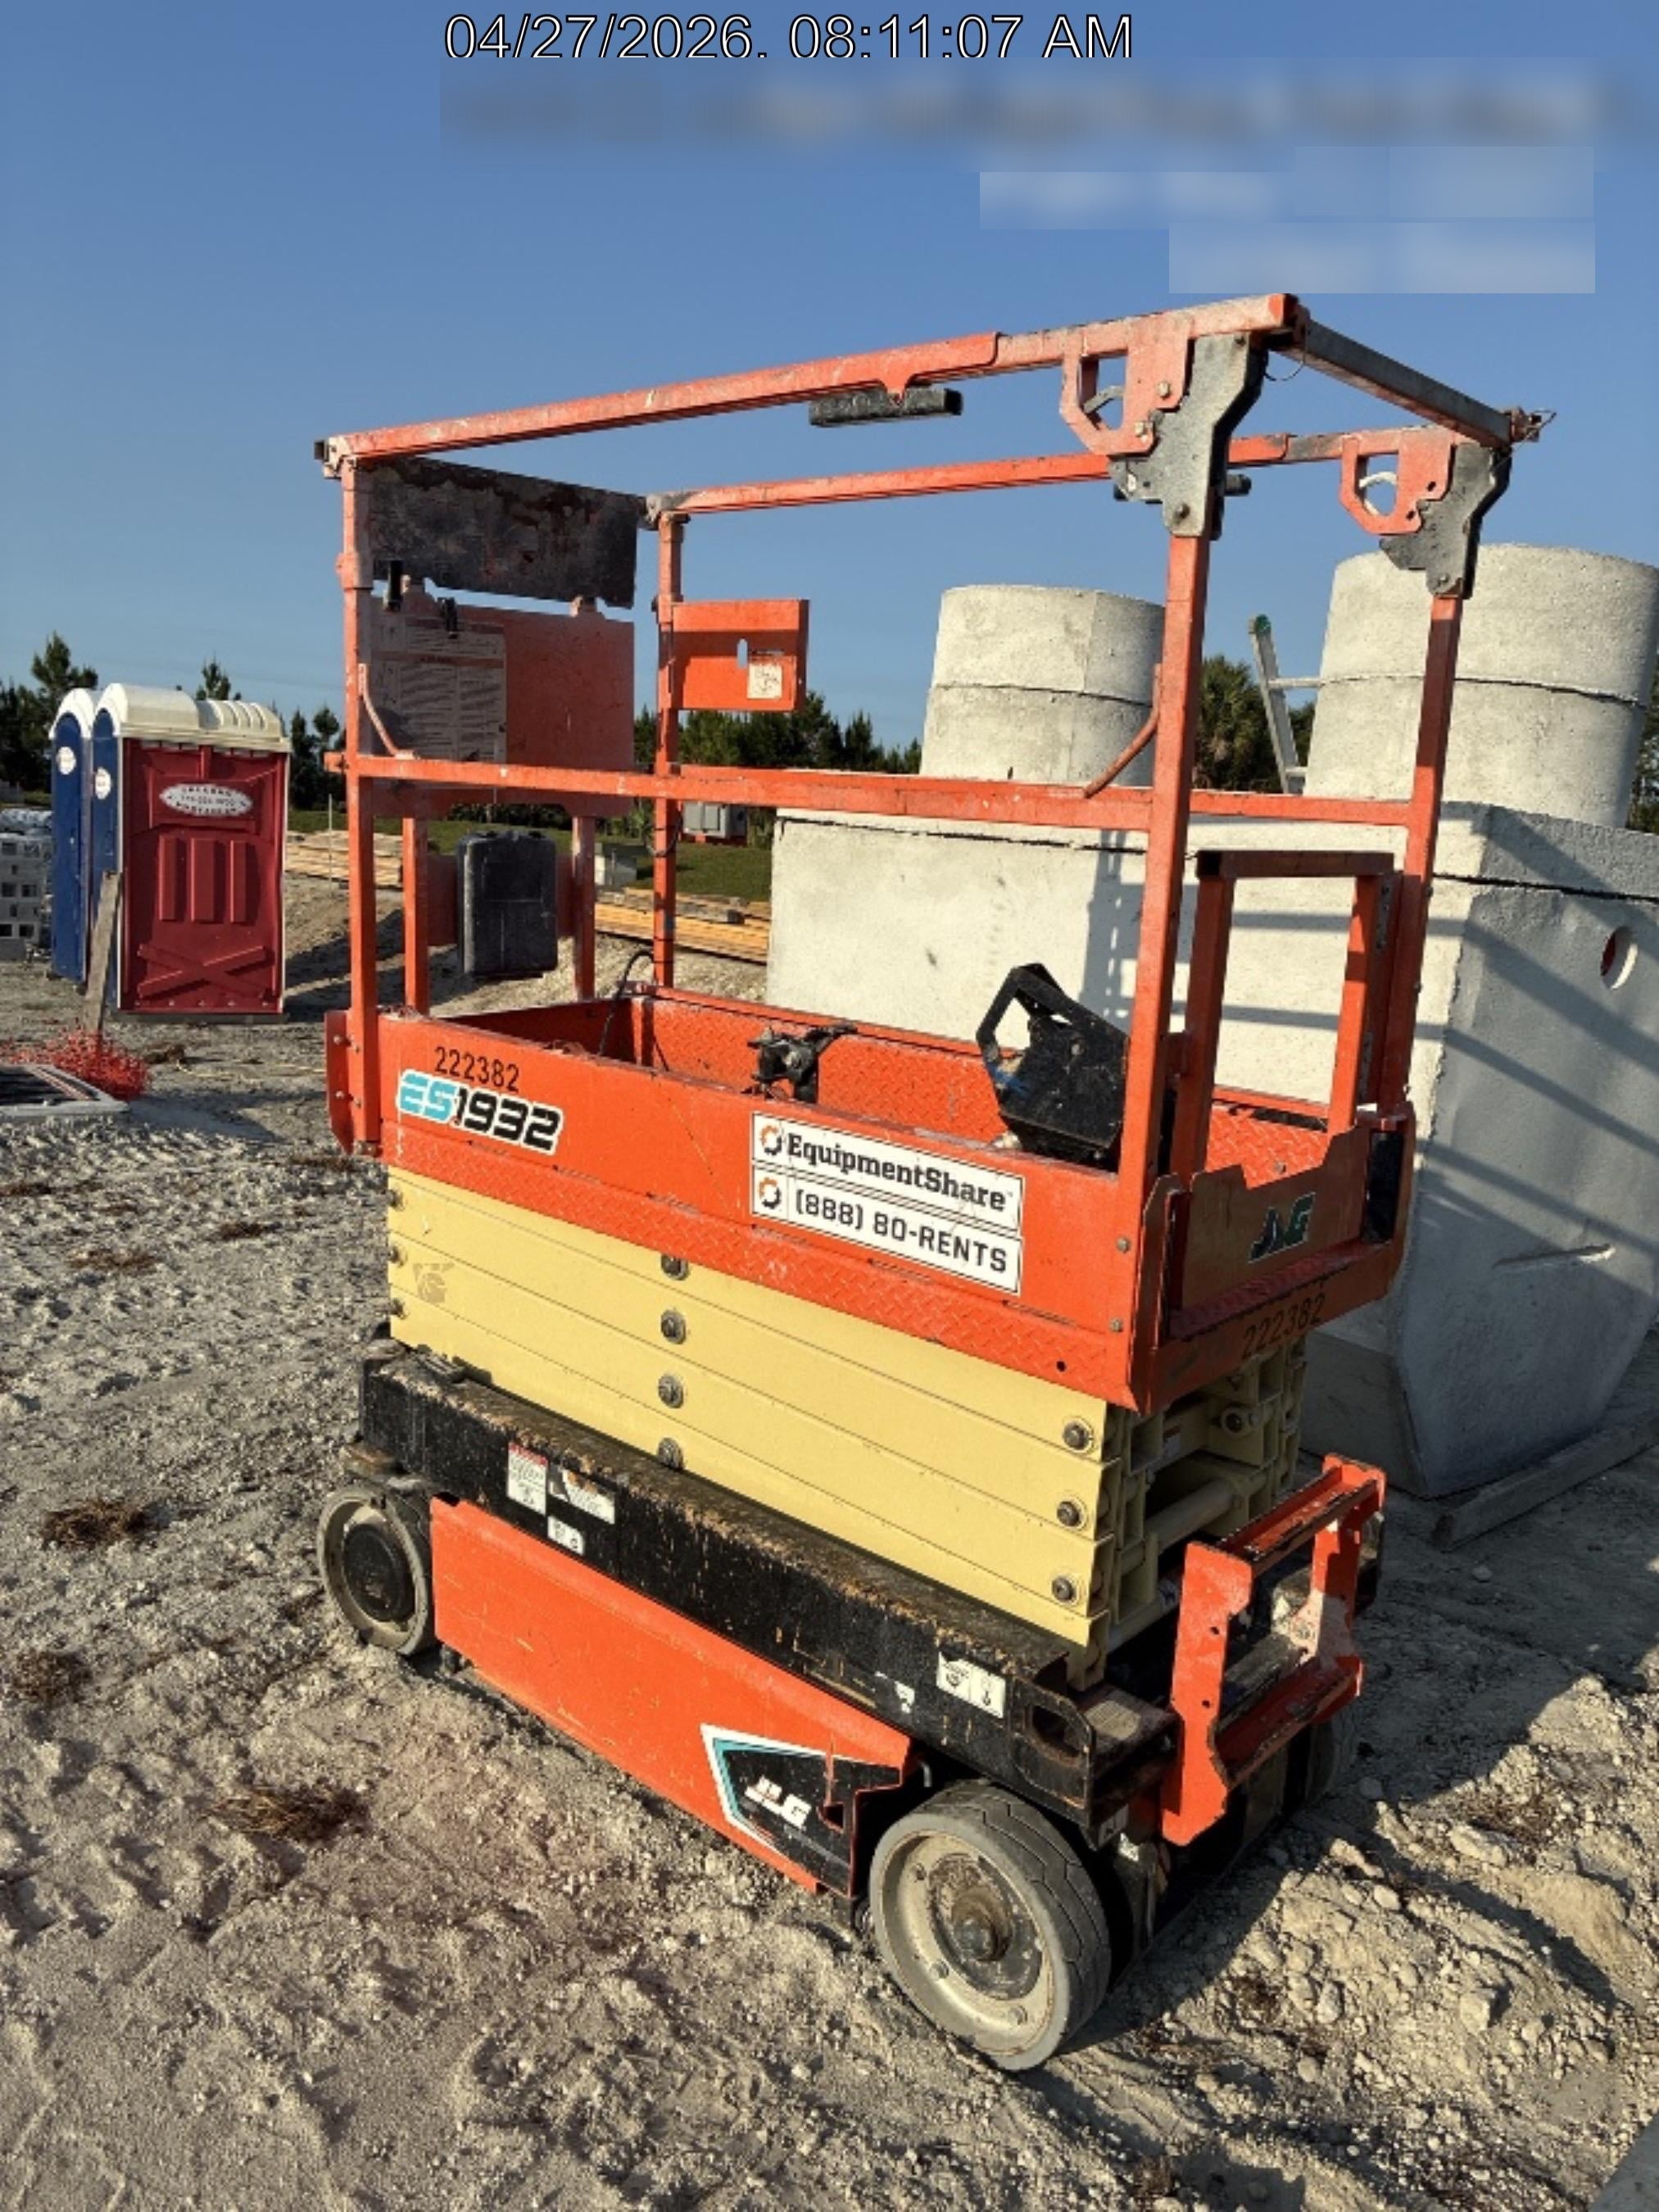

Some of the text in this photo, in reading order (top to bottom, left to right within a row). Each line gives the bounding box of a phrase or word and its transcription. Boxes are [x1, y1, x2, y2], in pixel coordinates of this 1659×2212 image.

[434, 1046, 519, 1093] 222382
[399, 1073, 561, 1151] ES1932
[787, 1133, 1007, 1212] EquipmentShare
[796, 1189, 1008, 1274] (888) 80-RENTS
[1241, 1292, 1326, 1362] 222382
[744, 1775, 811, 1829] JLG
